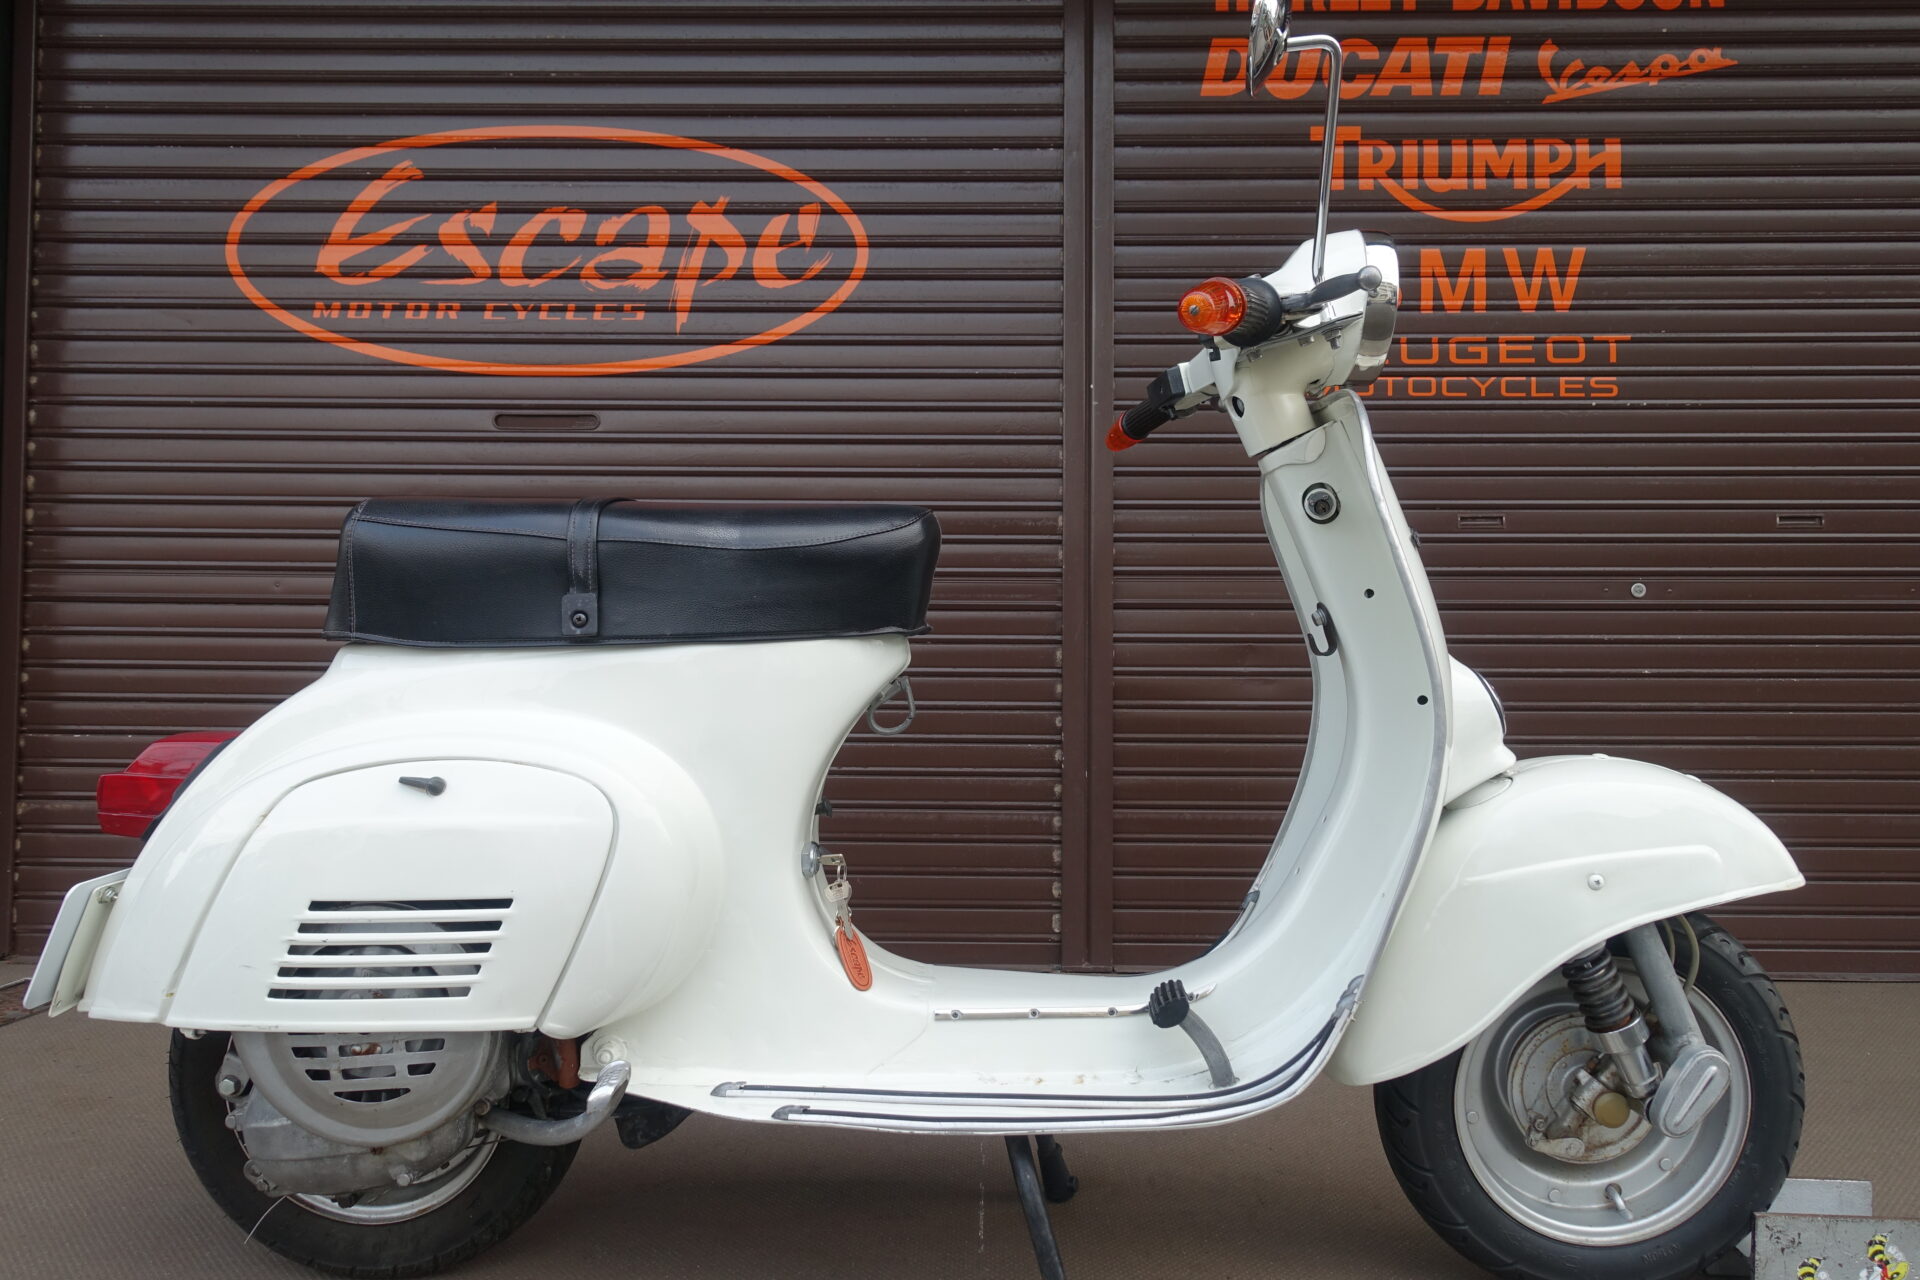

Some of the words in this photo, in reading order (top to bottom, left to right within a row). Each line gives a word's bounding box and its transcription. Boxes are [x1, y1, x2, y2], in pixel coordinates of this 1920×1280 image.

[1200, 36, 1511, 100] DUCATI
[1537, 38, 1738, 104] Vespa
[1310, 125, 1623, 222] TRIUMPH
[314, 159, 833, 335] Escape
[312, 301, 462, 319] MOTOR
[483, 302, 647, 321] CYCLES
[1397, 247, 1587, 313] MW
[1385, 335, 1632, 365] UGEOT
[1321, 376, 1619, 398] TOCYCLES
